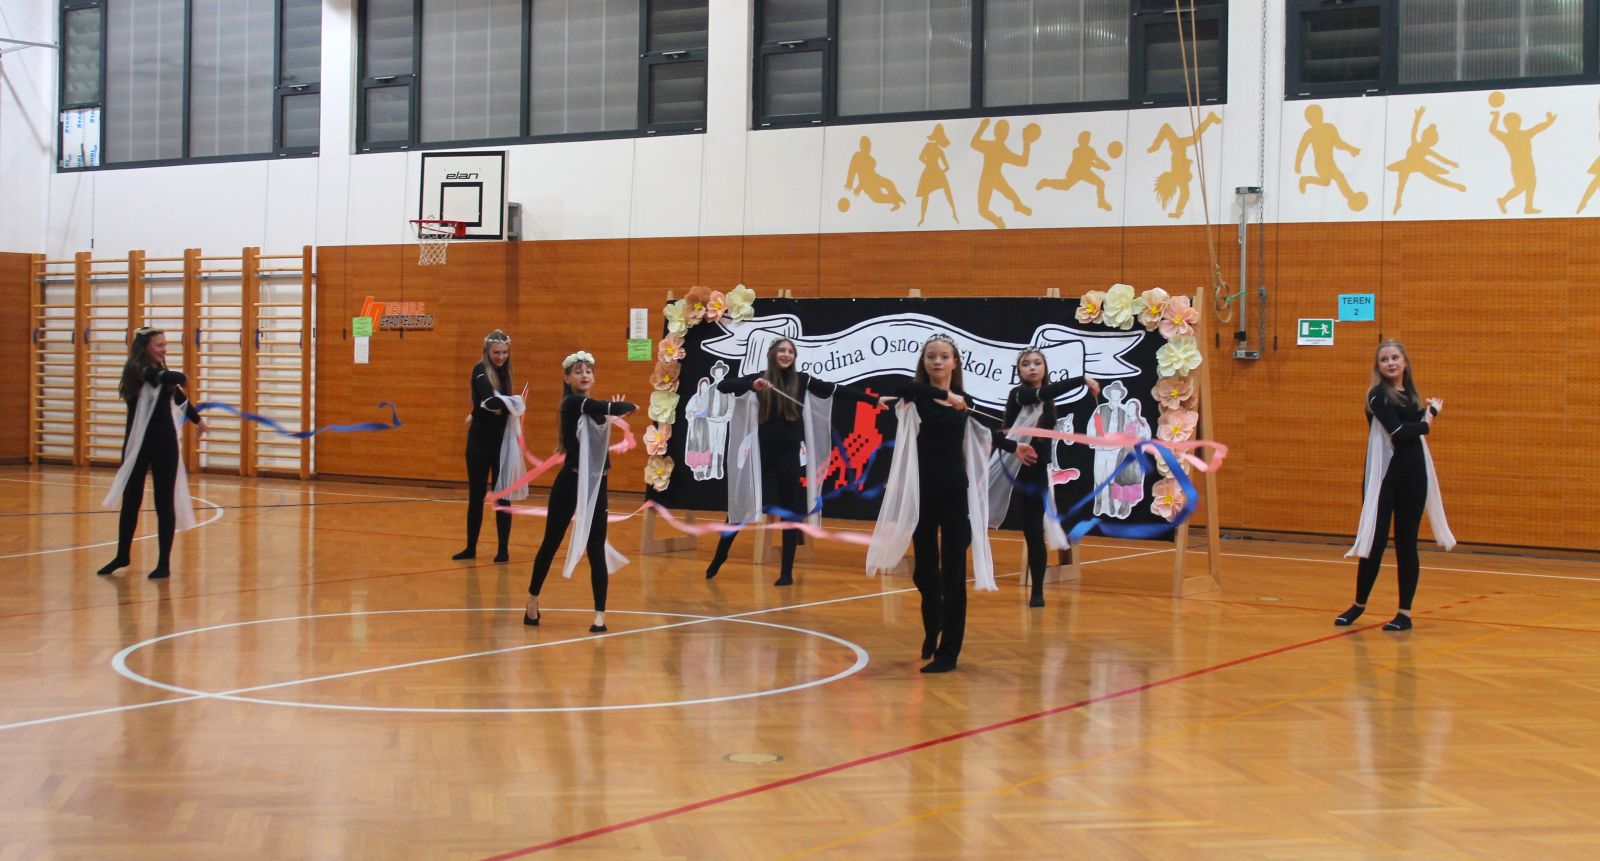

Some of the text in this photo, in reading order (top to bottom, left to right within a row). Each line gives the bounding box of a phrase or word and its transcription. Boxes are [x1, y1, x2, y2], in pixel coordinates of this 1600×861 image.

[445, 171, 479, 180] elan
[1342, 297, 1371, 305] TEREN
[1353, 308, 1360, 316] 2
[801, 350, 866, 375] godina
[870, 335, 923, 356] Osno
